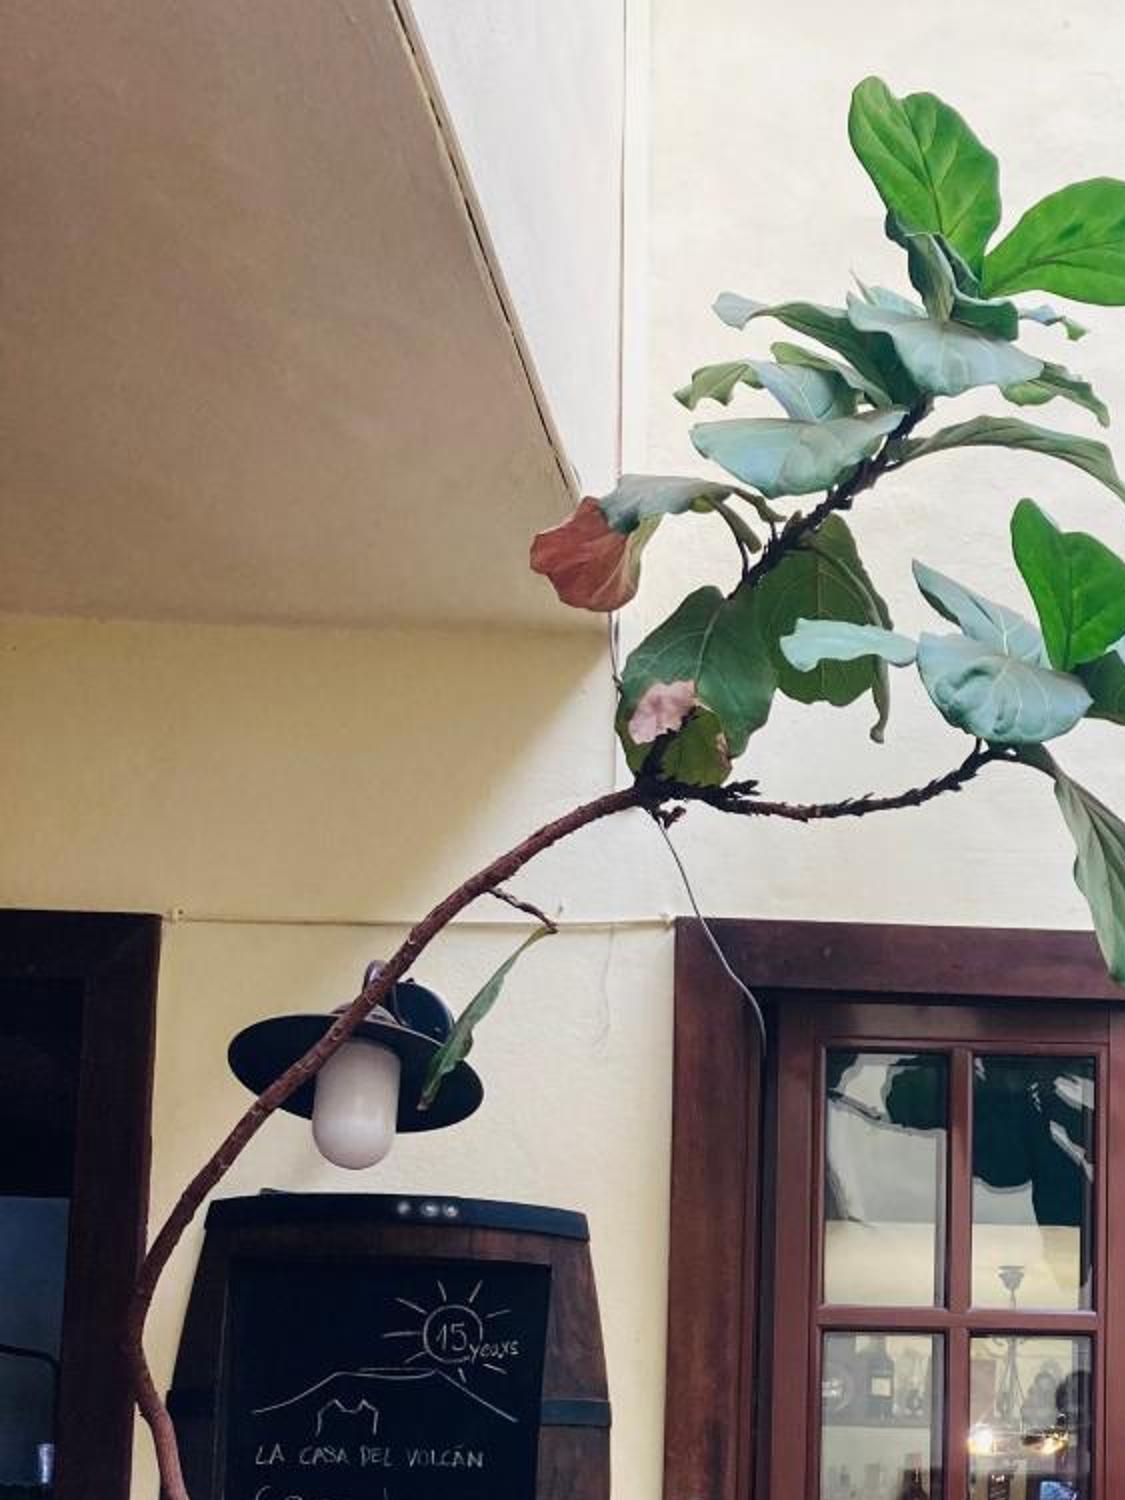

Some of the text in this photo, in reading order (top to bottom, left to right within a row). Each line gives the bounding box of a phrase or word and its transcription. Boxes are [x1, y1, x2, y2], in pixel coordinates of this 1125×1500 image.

[436, 1323, 520, 1364] 15 years
[255, 1443, 285, 1465] LA
[300, 1446, 349, 1465] CASA
[359, 1446, 393, 1467] DEL
